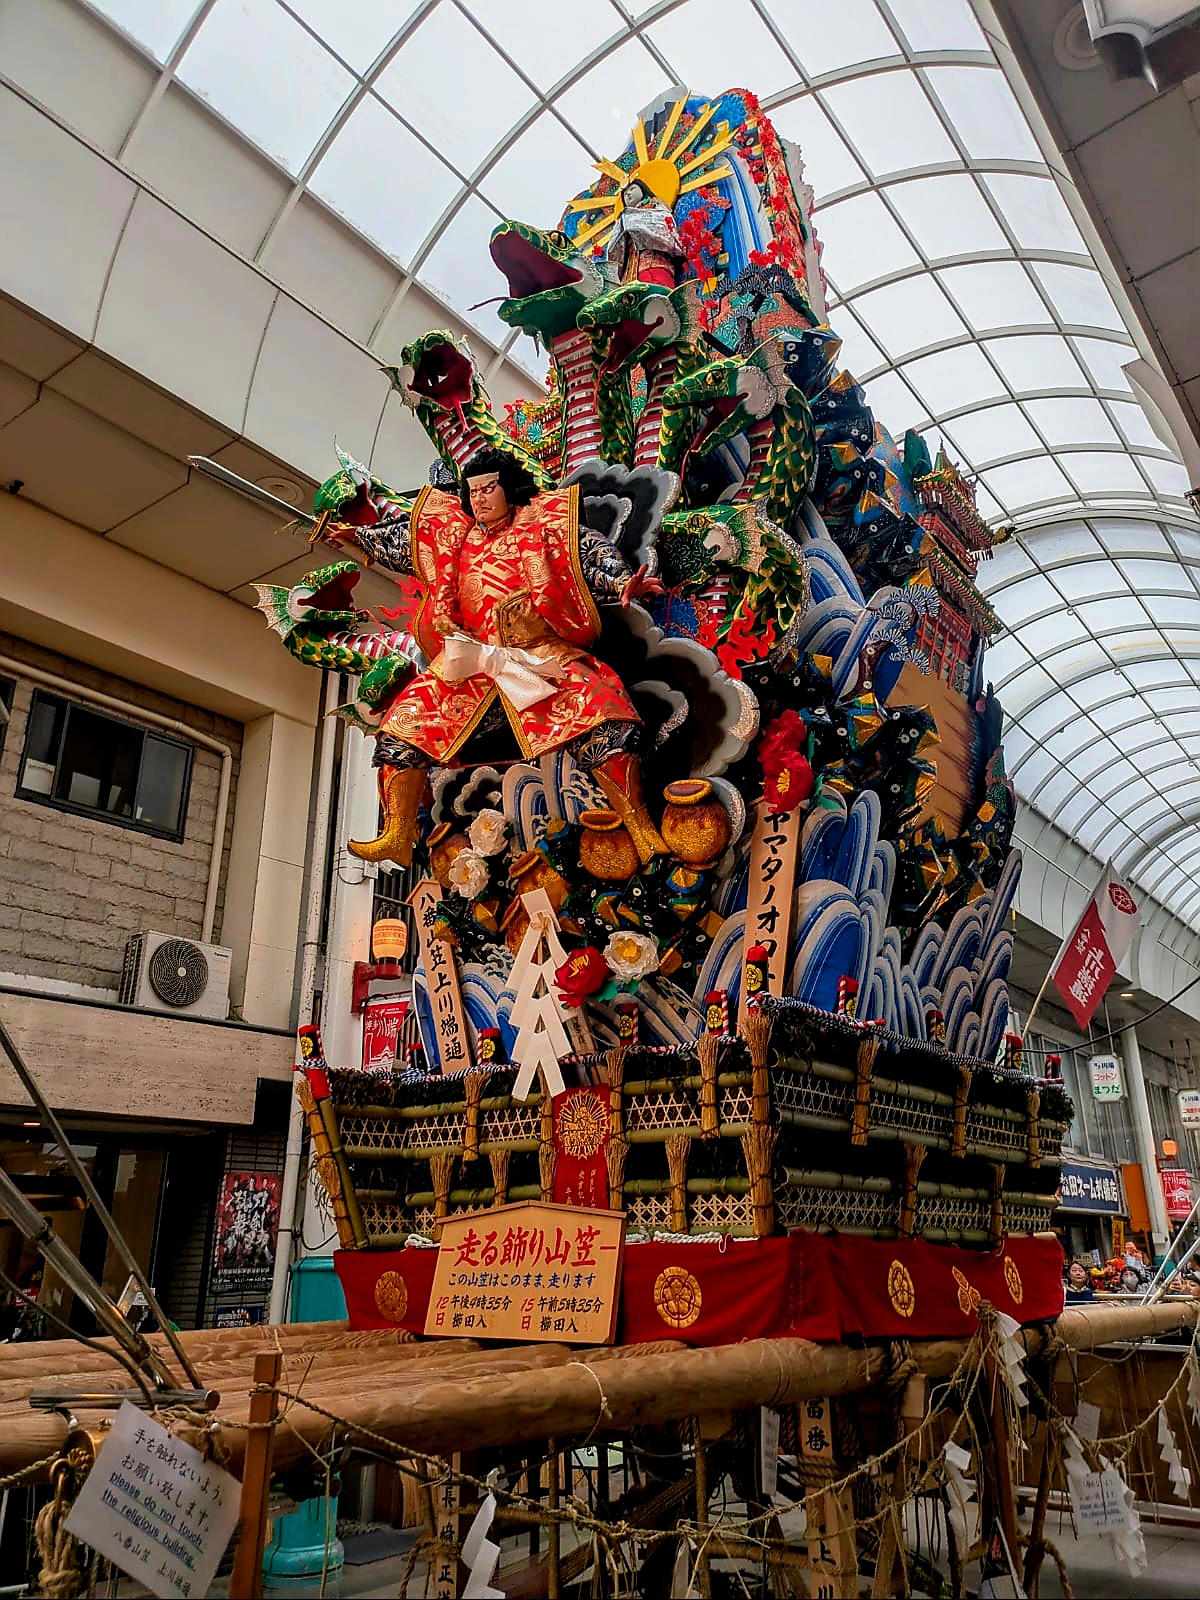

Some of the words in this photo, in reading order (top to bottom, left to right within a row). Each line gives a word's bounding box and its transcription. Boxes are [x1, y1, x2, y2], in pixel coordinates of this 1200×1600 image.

[1094, 1084, 1120, 1095] まつだ
[536, 1297, 604, 1314] 午前5時35分
[102, 1488, 118, 1506] the
[121, 1505, 160, 1539] religious
[109, 1471, 141, 1499] please
[144, 1495, 156, 1512] do
[160, 1508, 176, 1527] not
